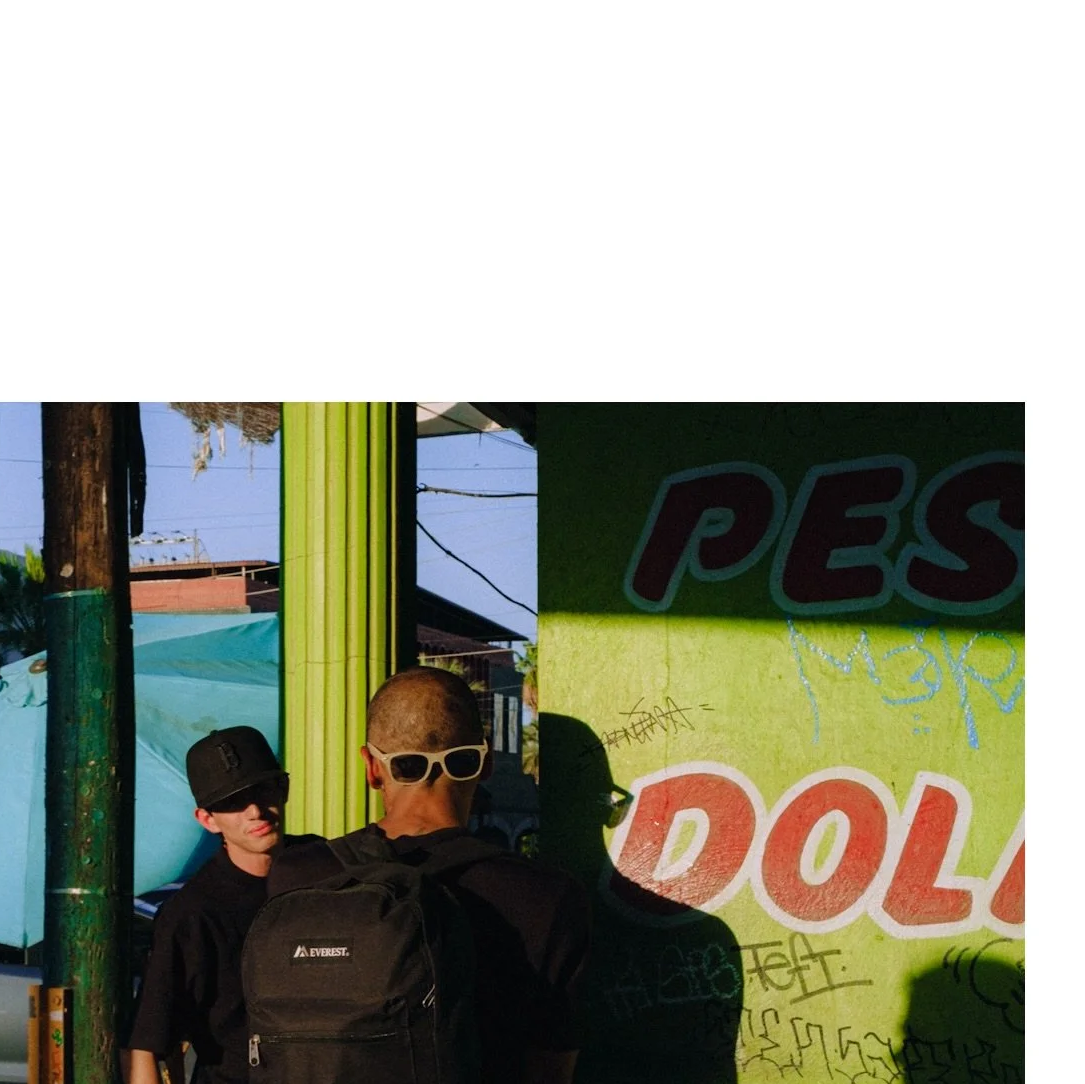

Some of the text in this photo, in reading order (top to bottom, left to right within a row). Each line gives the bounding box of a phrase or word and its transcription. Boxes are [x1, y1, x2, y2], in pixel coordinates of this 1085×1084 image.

[217, 742, 241, 771] B
[600, 761, 1024, 938] DOL
[309, 946, 348, 958] EVEREST
